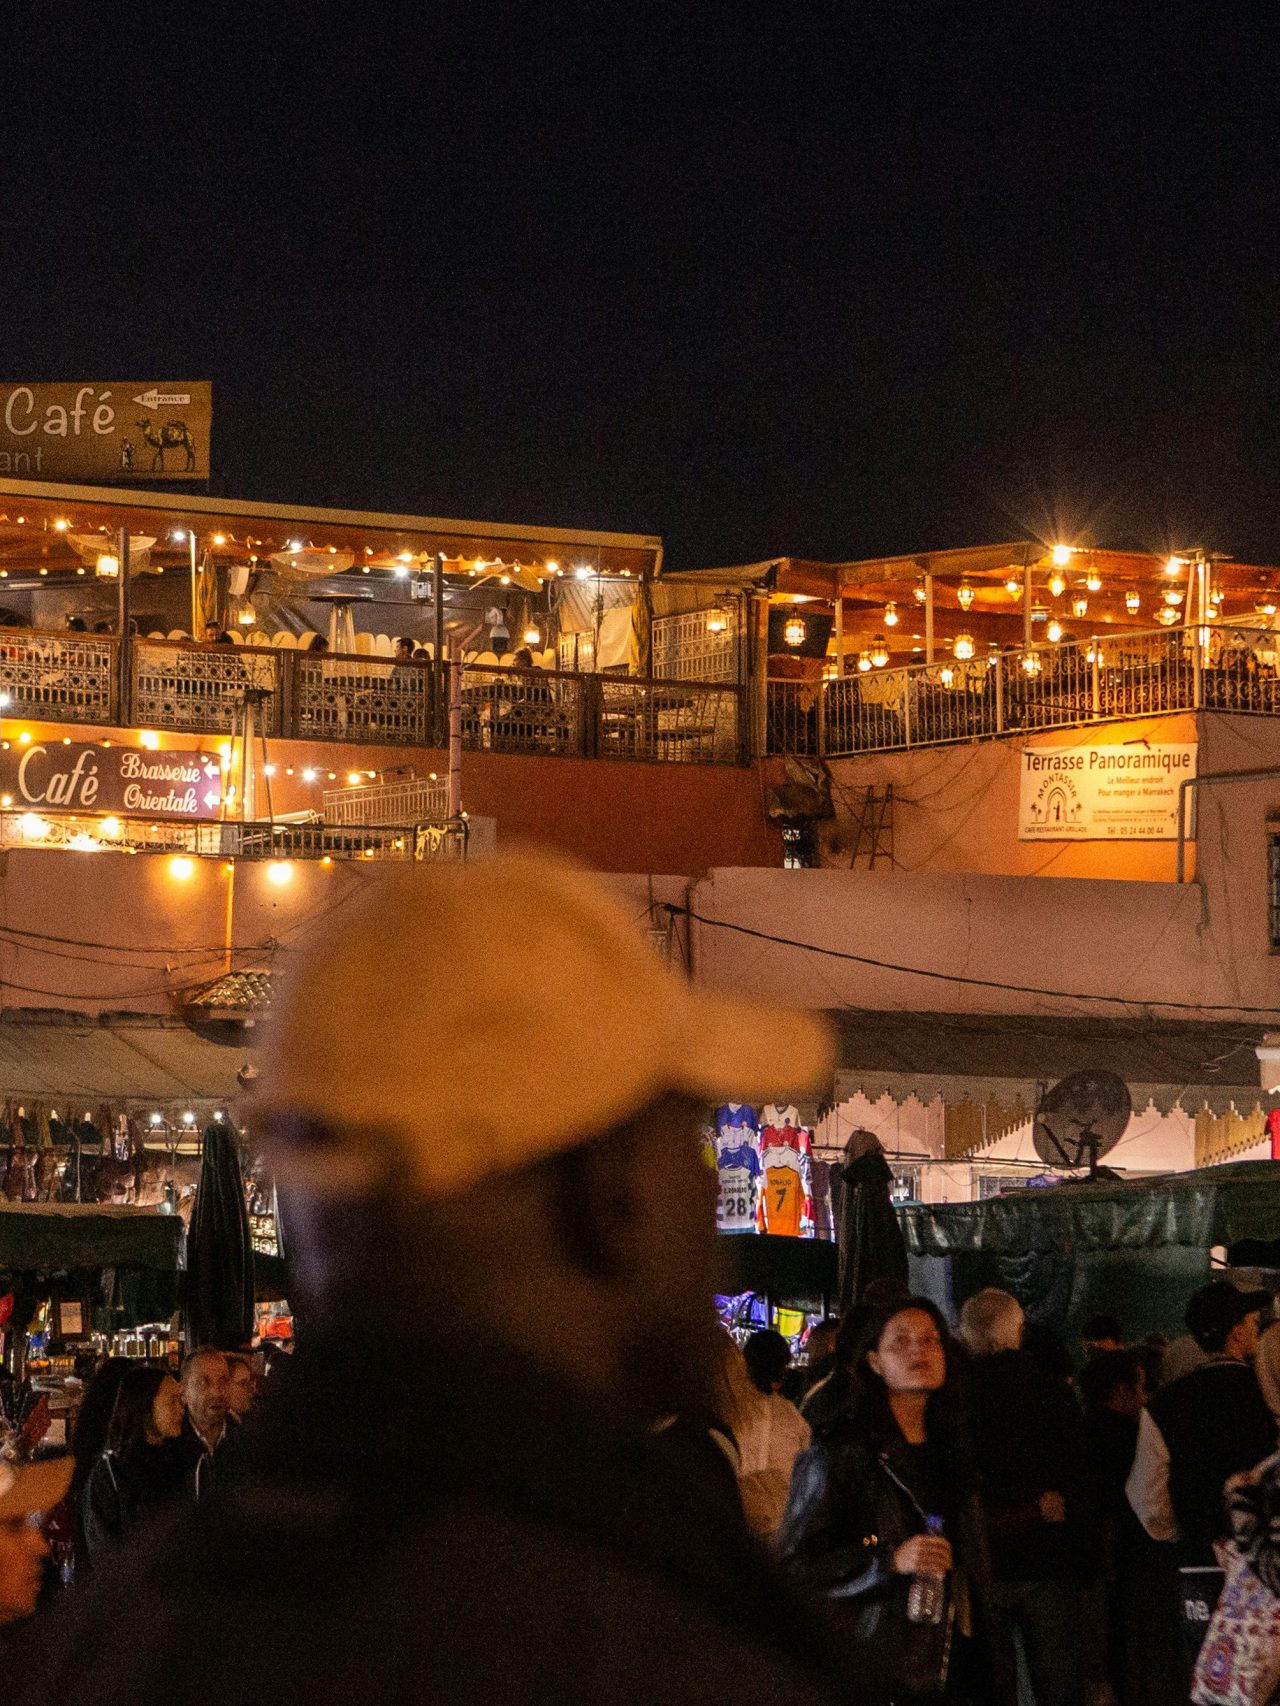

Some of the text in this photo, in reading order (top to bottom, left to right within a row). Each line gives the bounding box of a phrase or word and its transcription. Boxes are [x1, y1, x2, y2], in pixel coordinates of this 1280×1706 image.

[5, 387, 116, 436] Café
[120, 752, 200, 782] Brasserie
[1025, 748, 1191, 774] Terrasse Panoramique
[19, 746, 99, 805] Café
[1037, 772, 1077, 800] MONTASSIR
[124, 783, 198, 812] Orientale
[1098, 788, 1111, 796] Pour
[1113, 789, 1136, 798] manger
[1142, 788, 1174, 796] Marrakech
[725, 1197, 747, 1217] 28
[775, 1187, 786, 1212] 7
